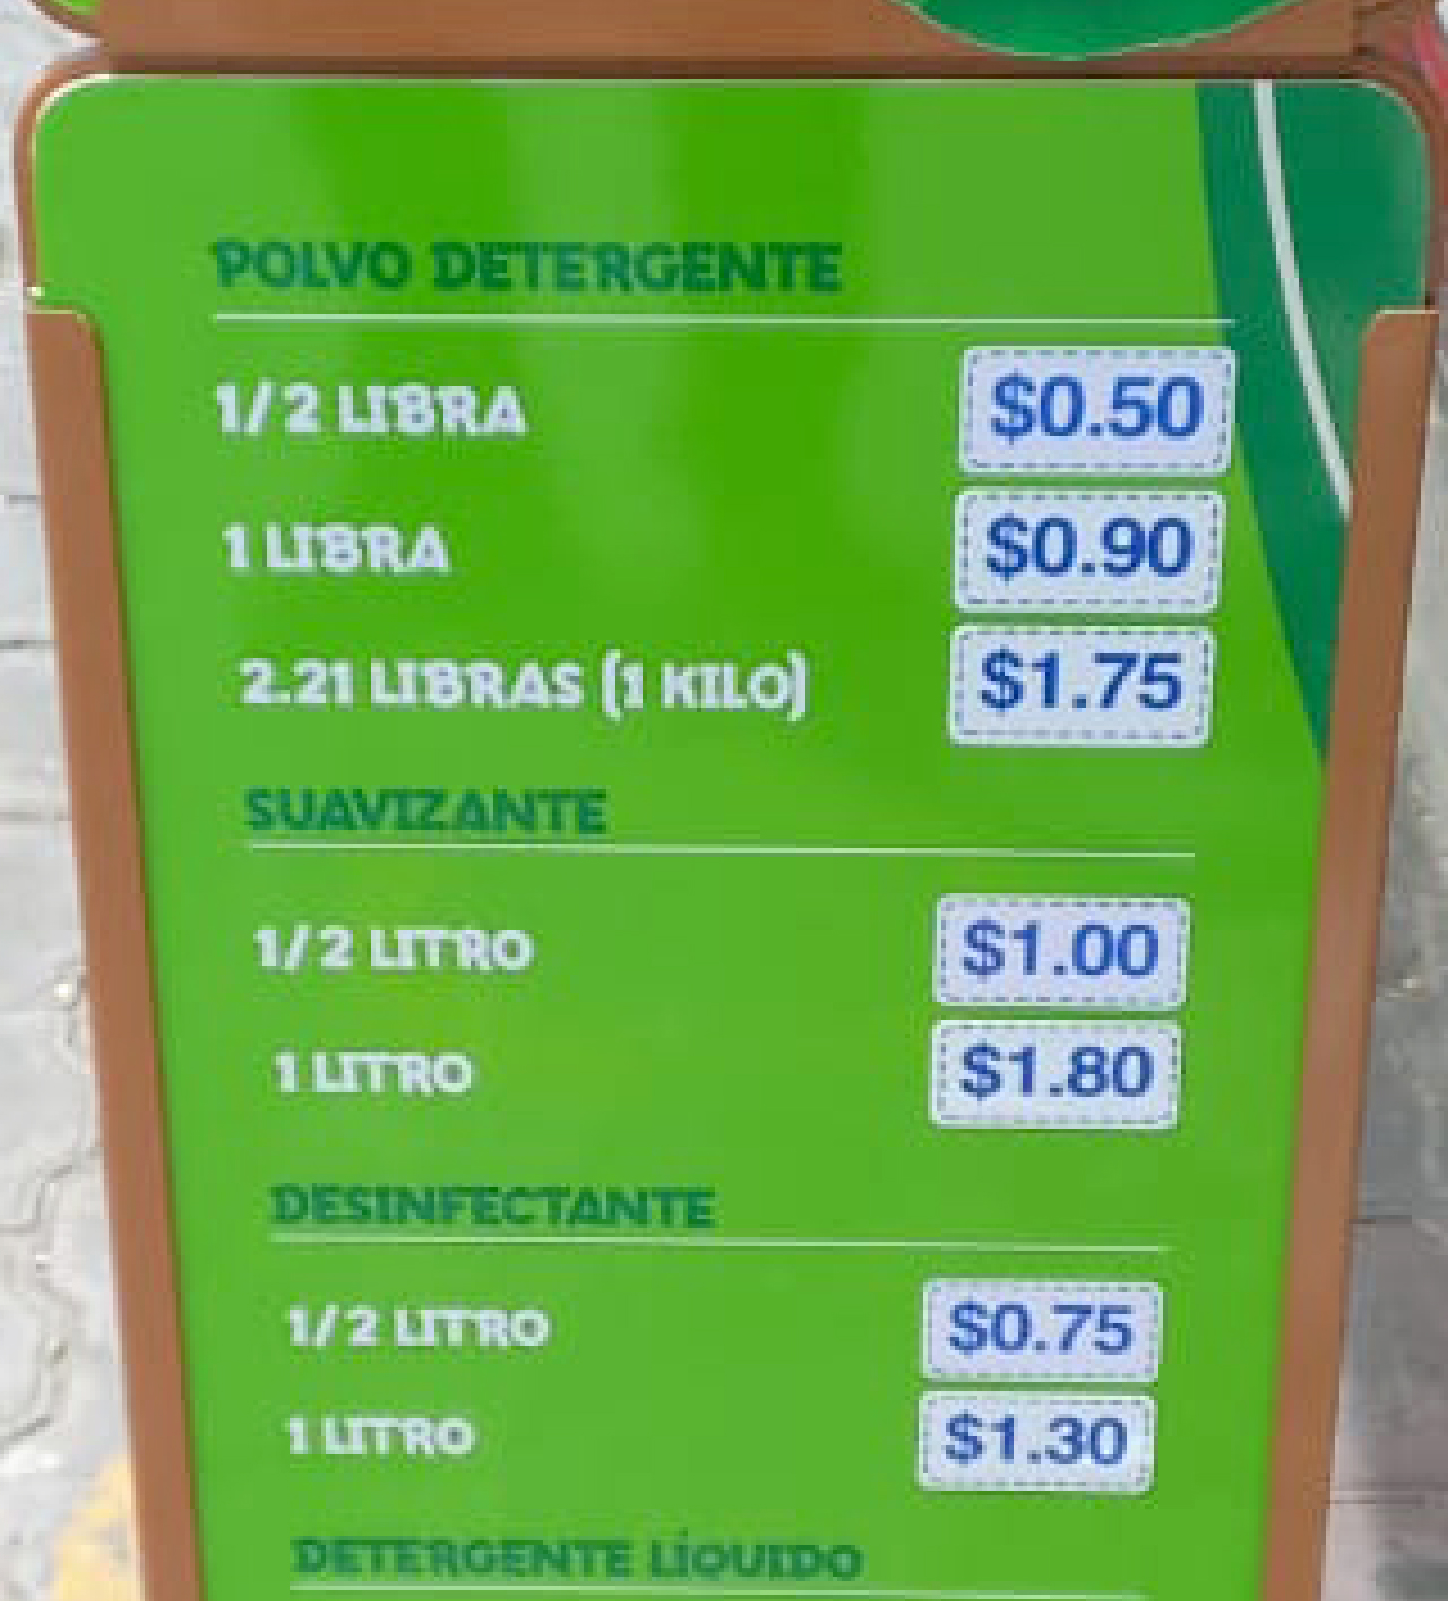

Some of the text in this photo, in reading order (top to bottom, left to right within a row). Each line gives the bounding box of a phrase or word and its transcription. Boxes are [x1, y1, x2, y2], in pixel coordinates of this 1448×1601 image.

[212, 241, 843, 292] POLVO DETERGENTE
[338, 385, 526, 433] LIBRA
[990, 372, 1205, 442] $0.50
[266, 521, 449, 573] LIBRA
[986, 512, 1196, 578] $0.90
[243, 657, 354, 704] 2.21
[370, 662, 585, 709] LIBRAS
[981, 648, 1182, 713] $1.75
[248, 788, 607, 835] SUAVIZANTE
[257, 919, 1159, 976] 1/2 LITRO $1.00
[311, 1051, 472, 1093] LITRO
[960, 1046, 1155, 1102] $1.80
[270, 1182, 716, 1229] DESINFECTANTE
[289, 1300, 1132, 1356] 1/2 LITRO $0.75
[325, 1417, 476, 1455] LITRO
[945, 1417, 1128, 1465] $1.30
[293, 1529, 865, 1582] DETERGENTE LÍQUIDO
